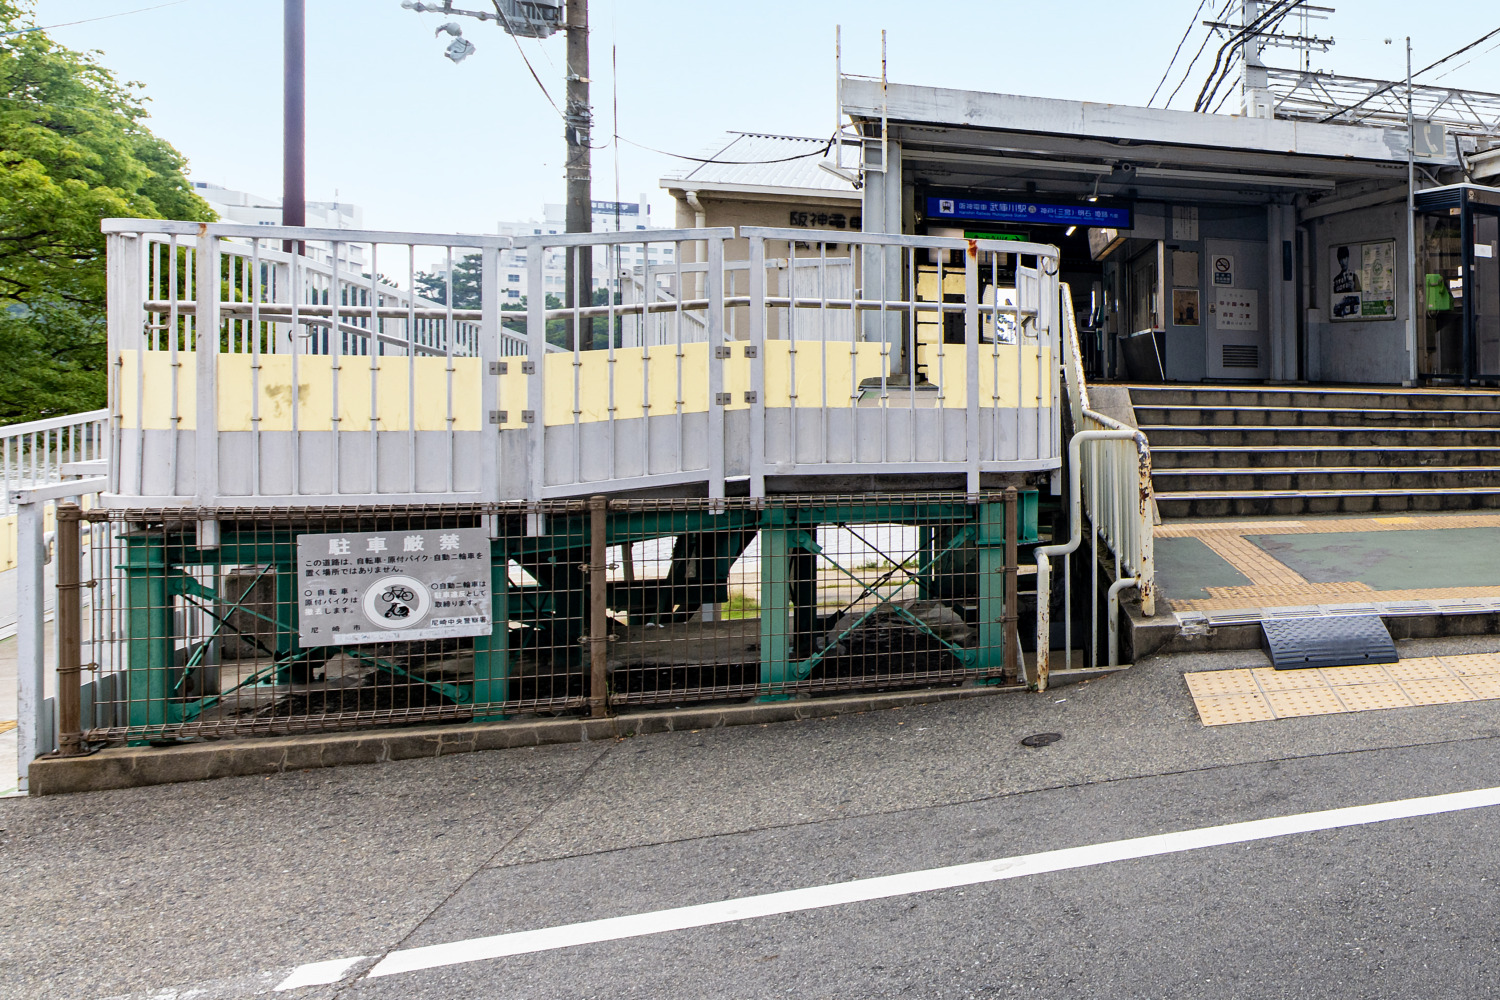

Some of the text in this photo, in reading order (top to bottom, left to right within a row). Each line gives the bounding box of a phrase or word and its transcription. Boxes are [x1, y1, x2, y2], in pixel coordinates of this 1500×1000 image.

[990, 203, 1027, 213] 武庫川駅
[328, 534, 460, 555] 駐車厳禁
[305, 566, 404, 577] 置く場所ではありません。
[305, 597, 358, 606] 原付バイクは
